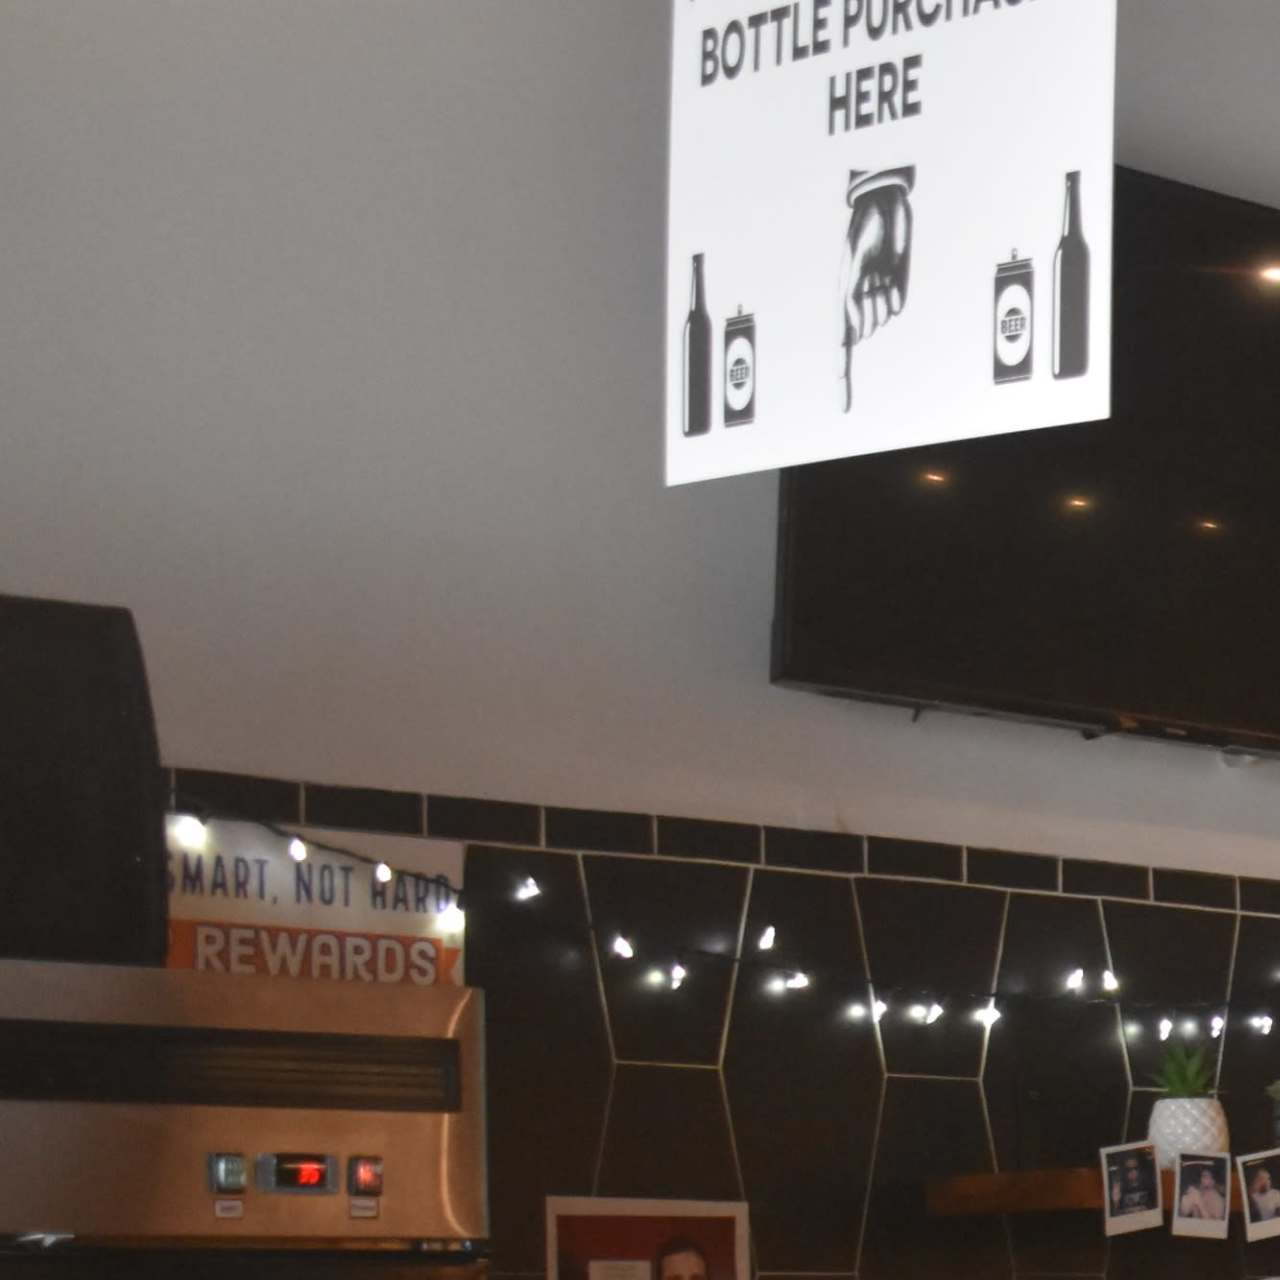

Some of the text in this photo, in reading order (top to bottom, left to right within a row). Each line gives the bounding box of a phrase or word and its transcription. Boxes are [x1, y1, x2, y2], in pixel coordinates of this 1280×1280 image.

[700, 0, 831, 86] BOTTLE
[829, 54, 922, 136] HERE
[1000, 317, 1027, 334] BEER
[729, 365, 750, 382] BEER
[295, 862, 354, 907] NOT
[196, 925, 437, 987] REWARDS
